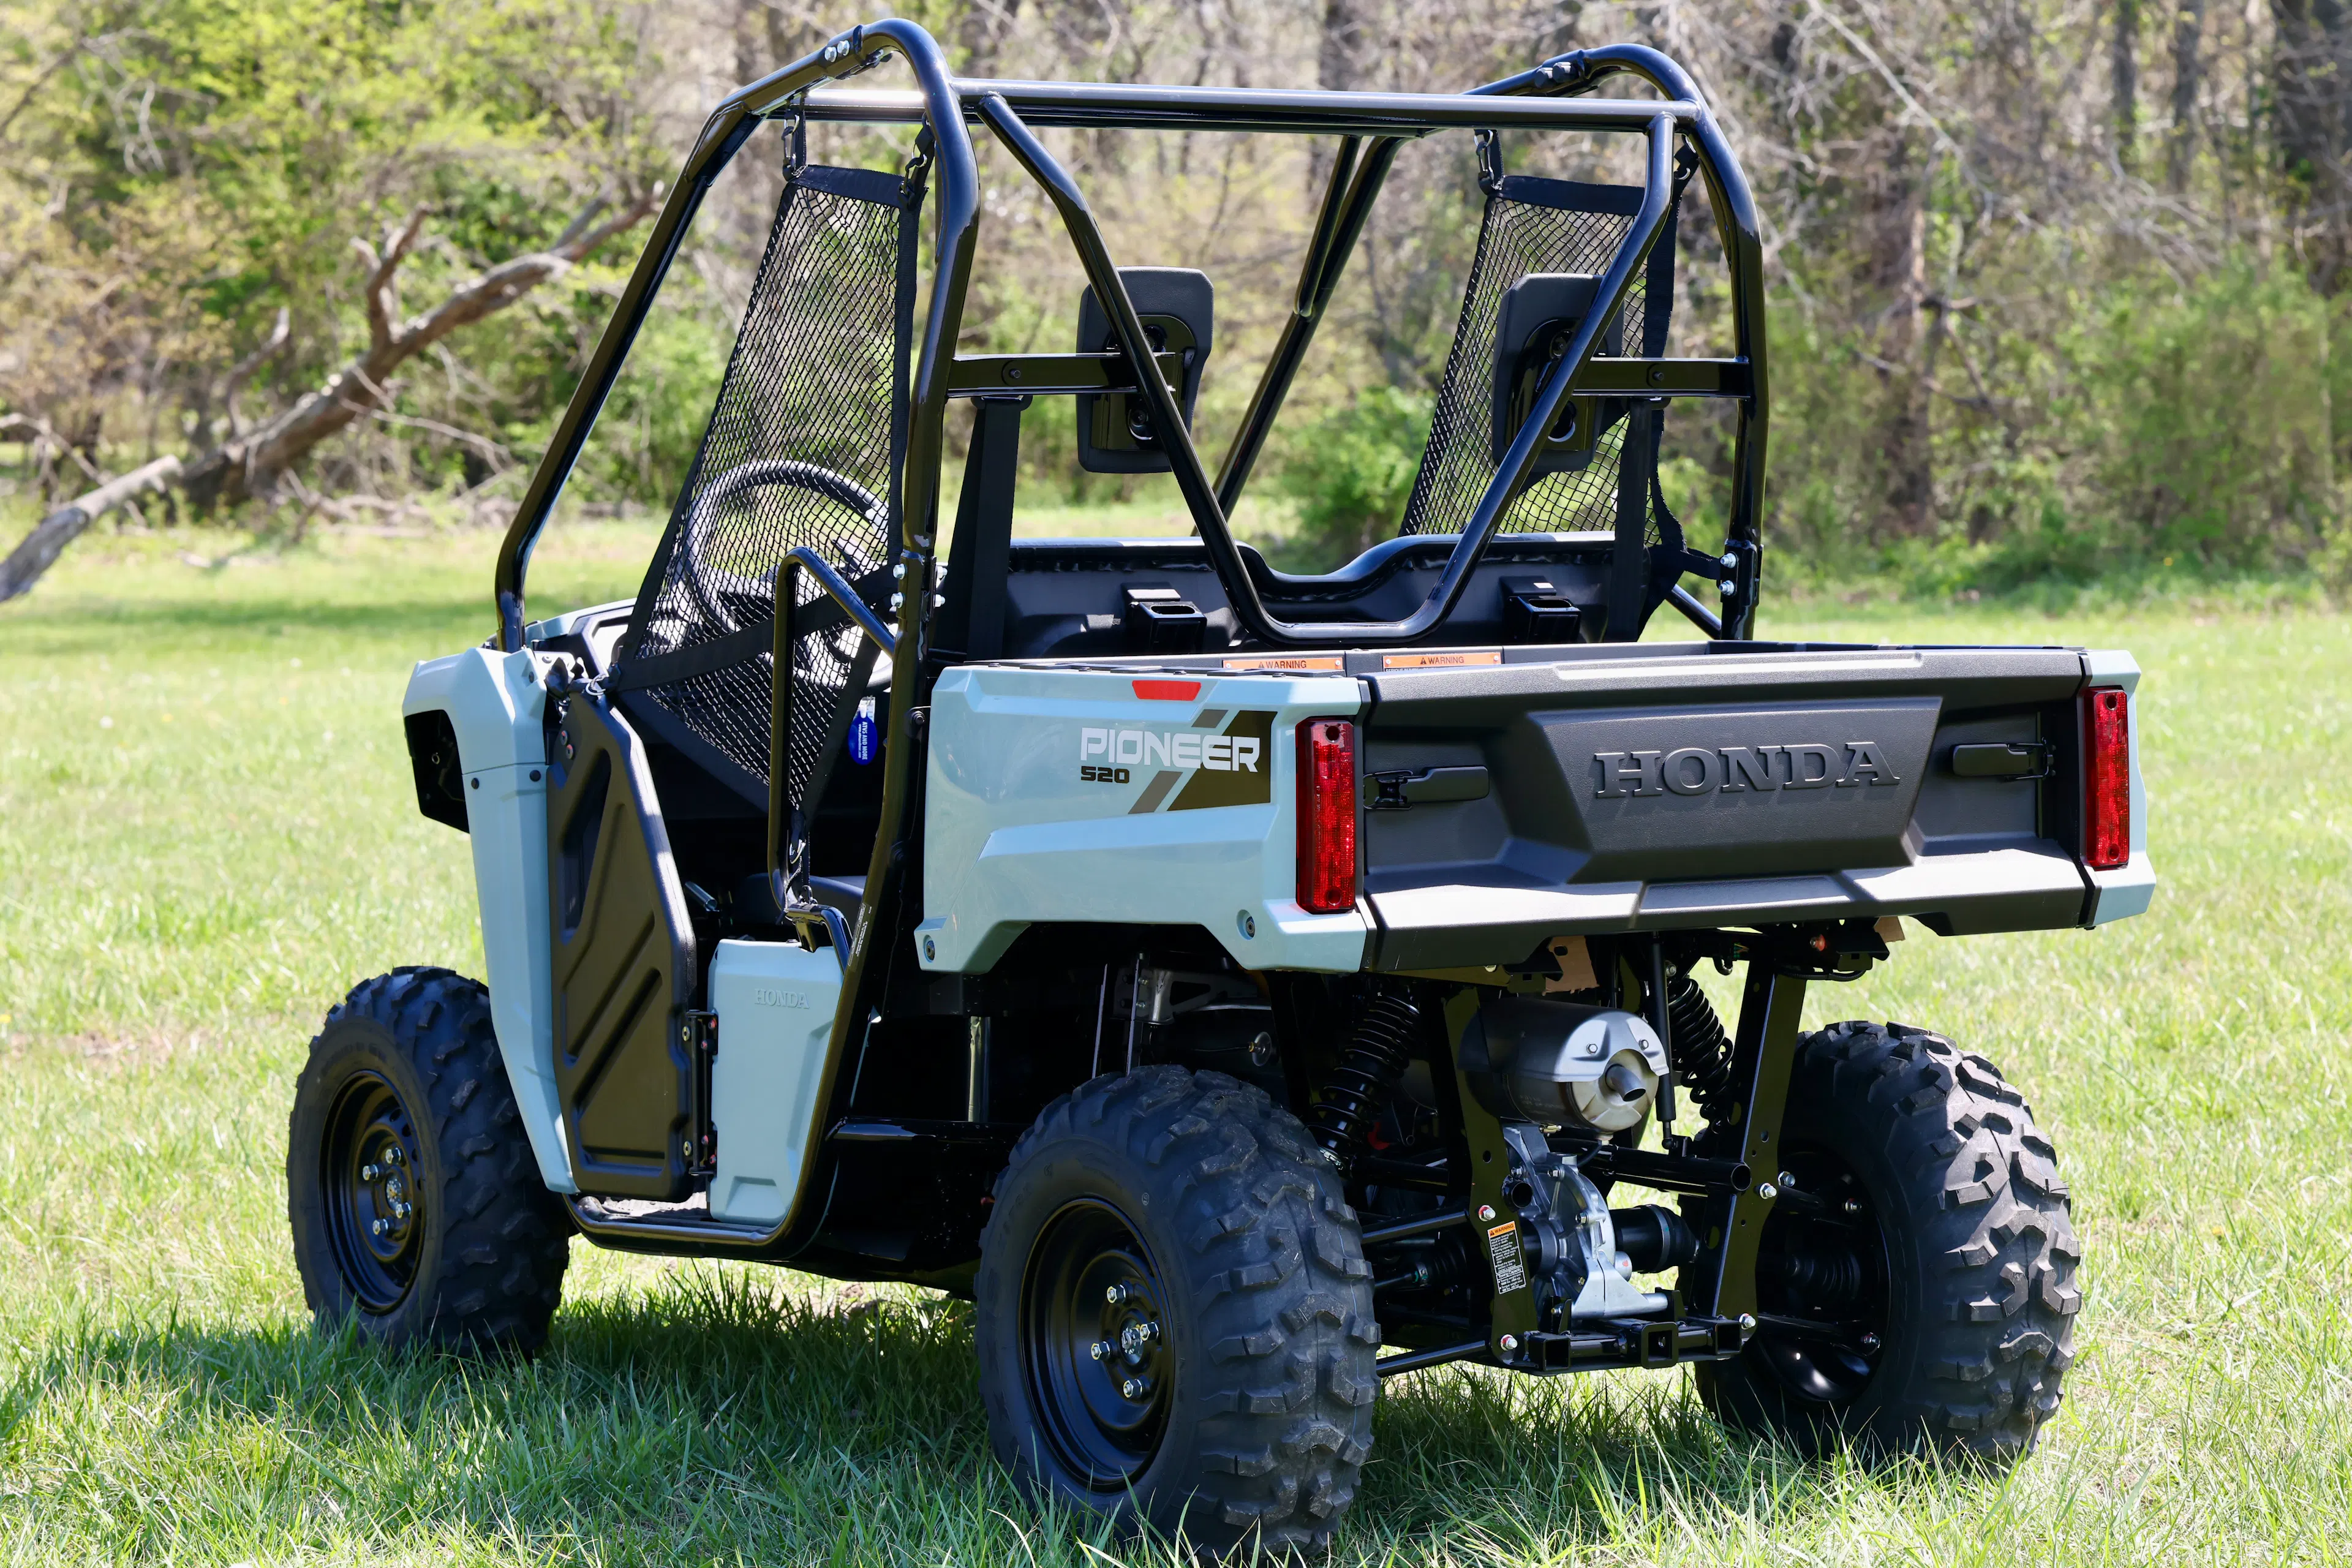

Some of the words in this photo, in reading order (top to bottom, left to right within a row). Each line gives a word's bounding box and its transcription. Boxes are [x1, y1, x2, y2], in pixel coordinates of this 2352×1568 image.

[1265, 660, 1306, 669] WARNING
[1428, 656, 1464, 665] WARNING
[1080, 727, 1260, 773] PIONEER
[1080, 766, 1129, 784] 520
[1594, 741, 1900, 798] HONDA
[755, 988, 810, 1009] HONDA
[1494, 1224, 1513, 1233] WARNING
[1498, 1271, 1509, 1280] Towing
[1509, 1267, 1521, 1275] Capacity
